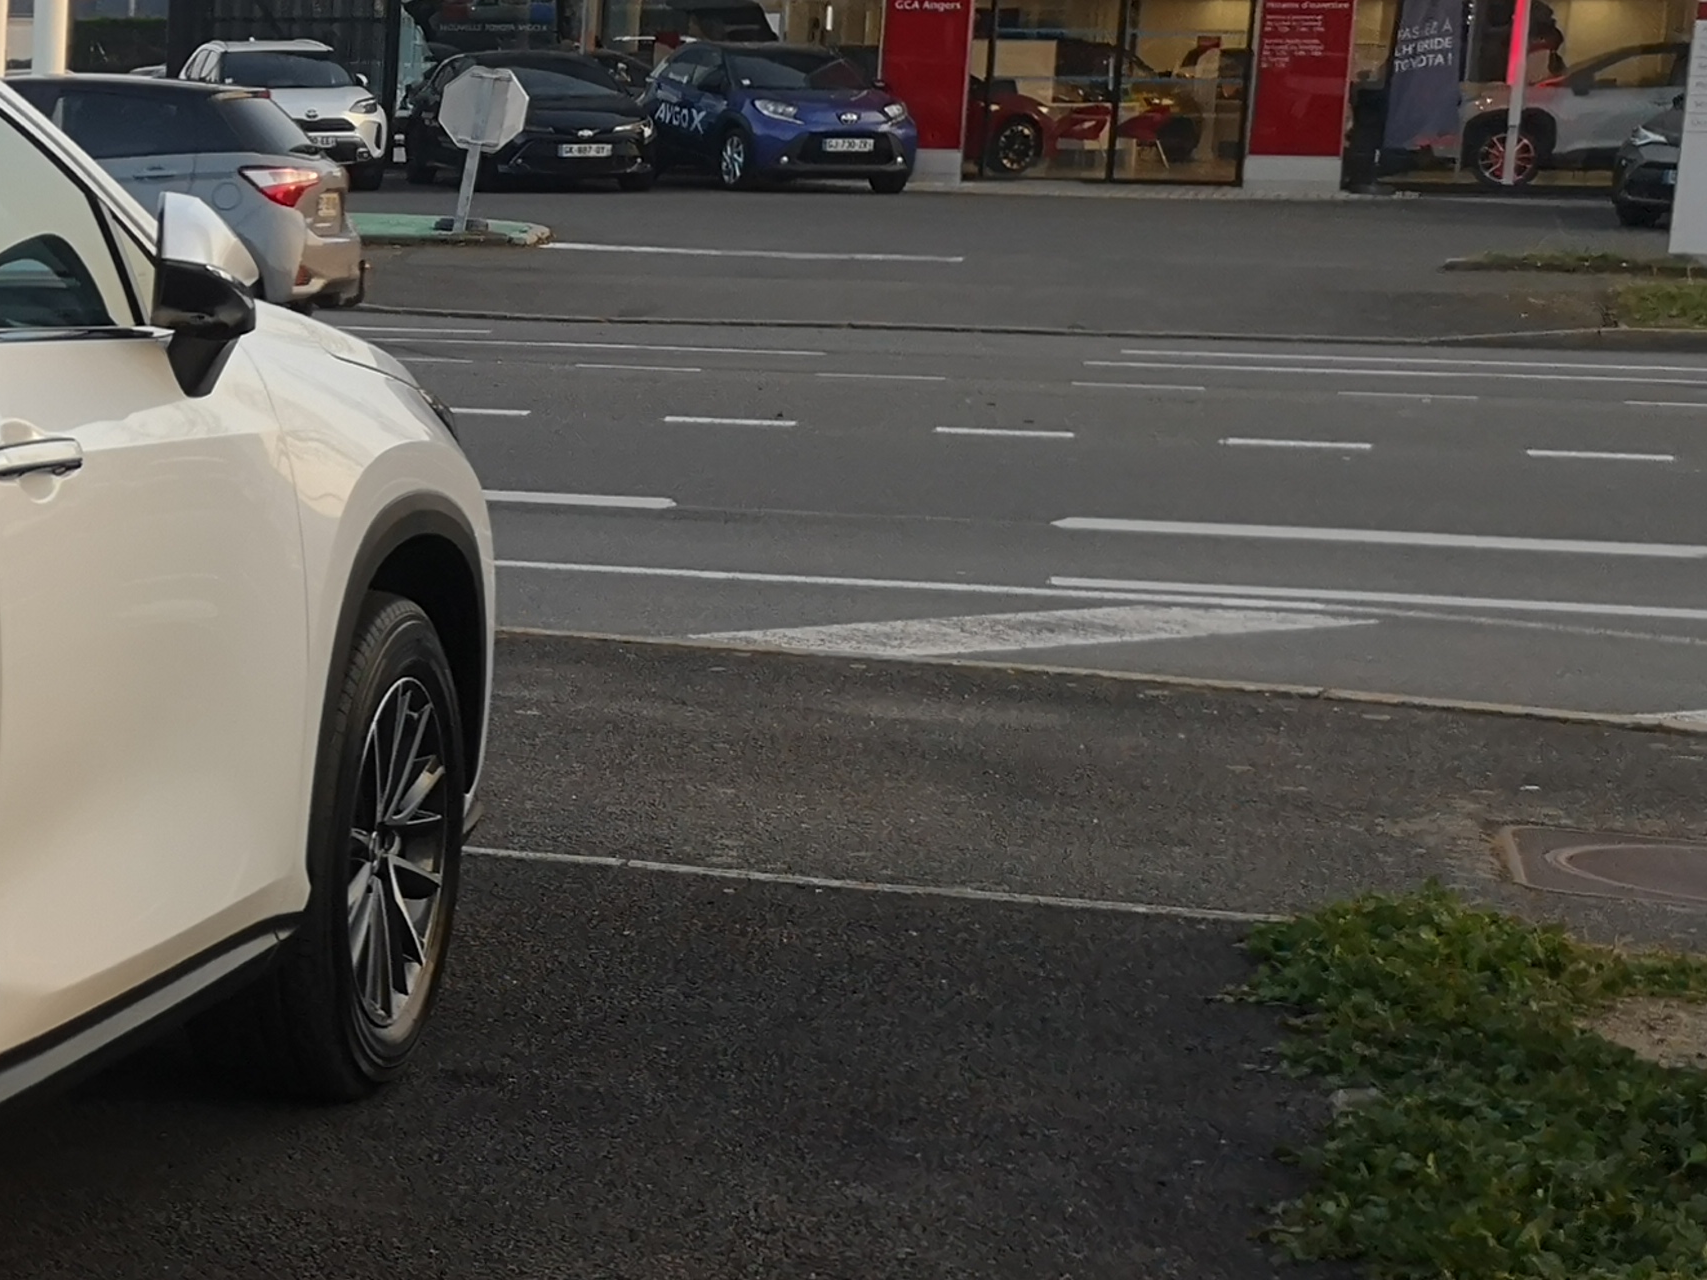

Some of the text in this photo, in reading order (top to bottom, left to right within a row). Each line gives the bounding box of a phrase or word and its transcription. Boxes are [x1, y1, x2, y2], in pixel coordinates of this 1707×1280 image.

[894, 0, 962, 12] GCA Angers
[654, 102, 708, 135] AYGO X
